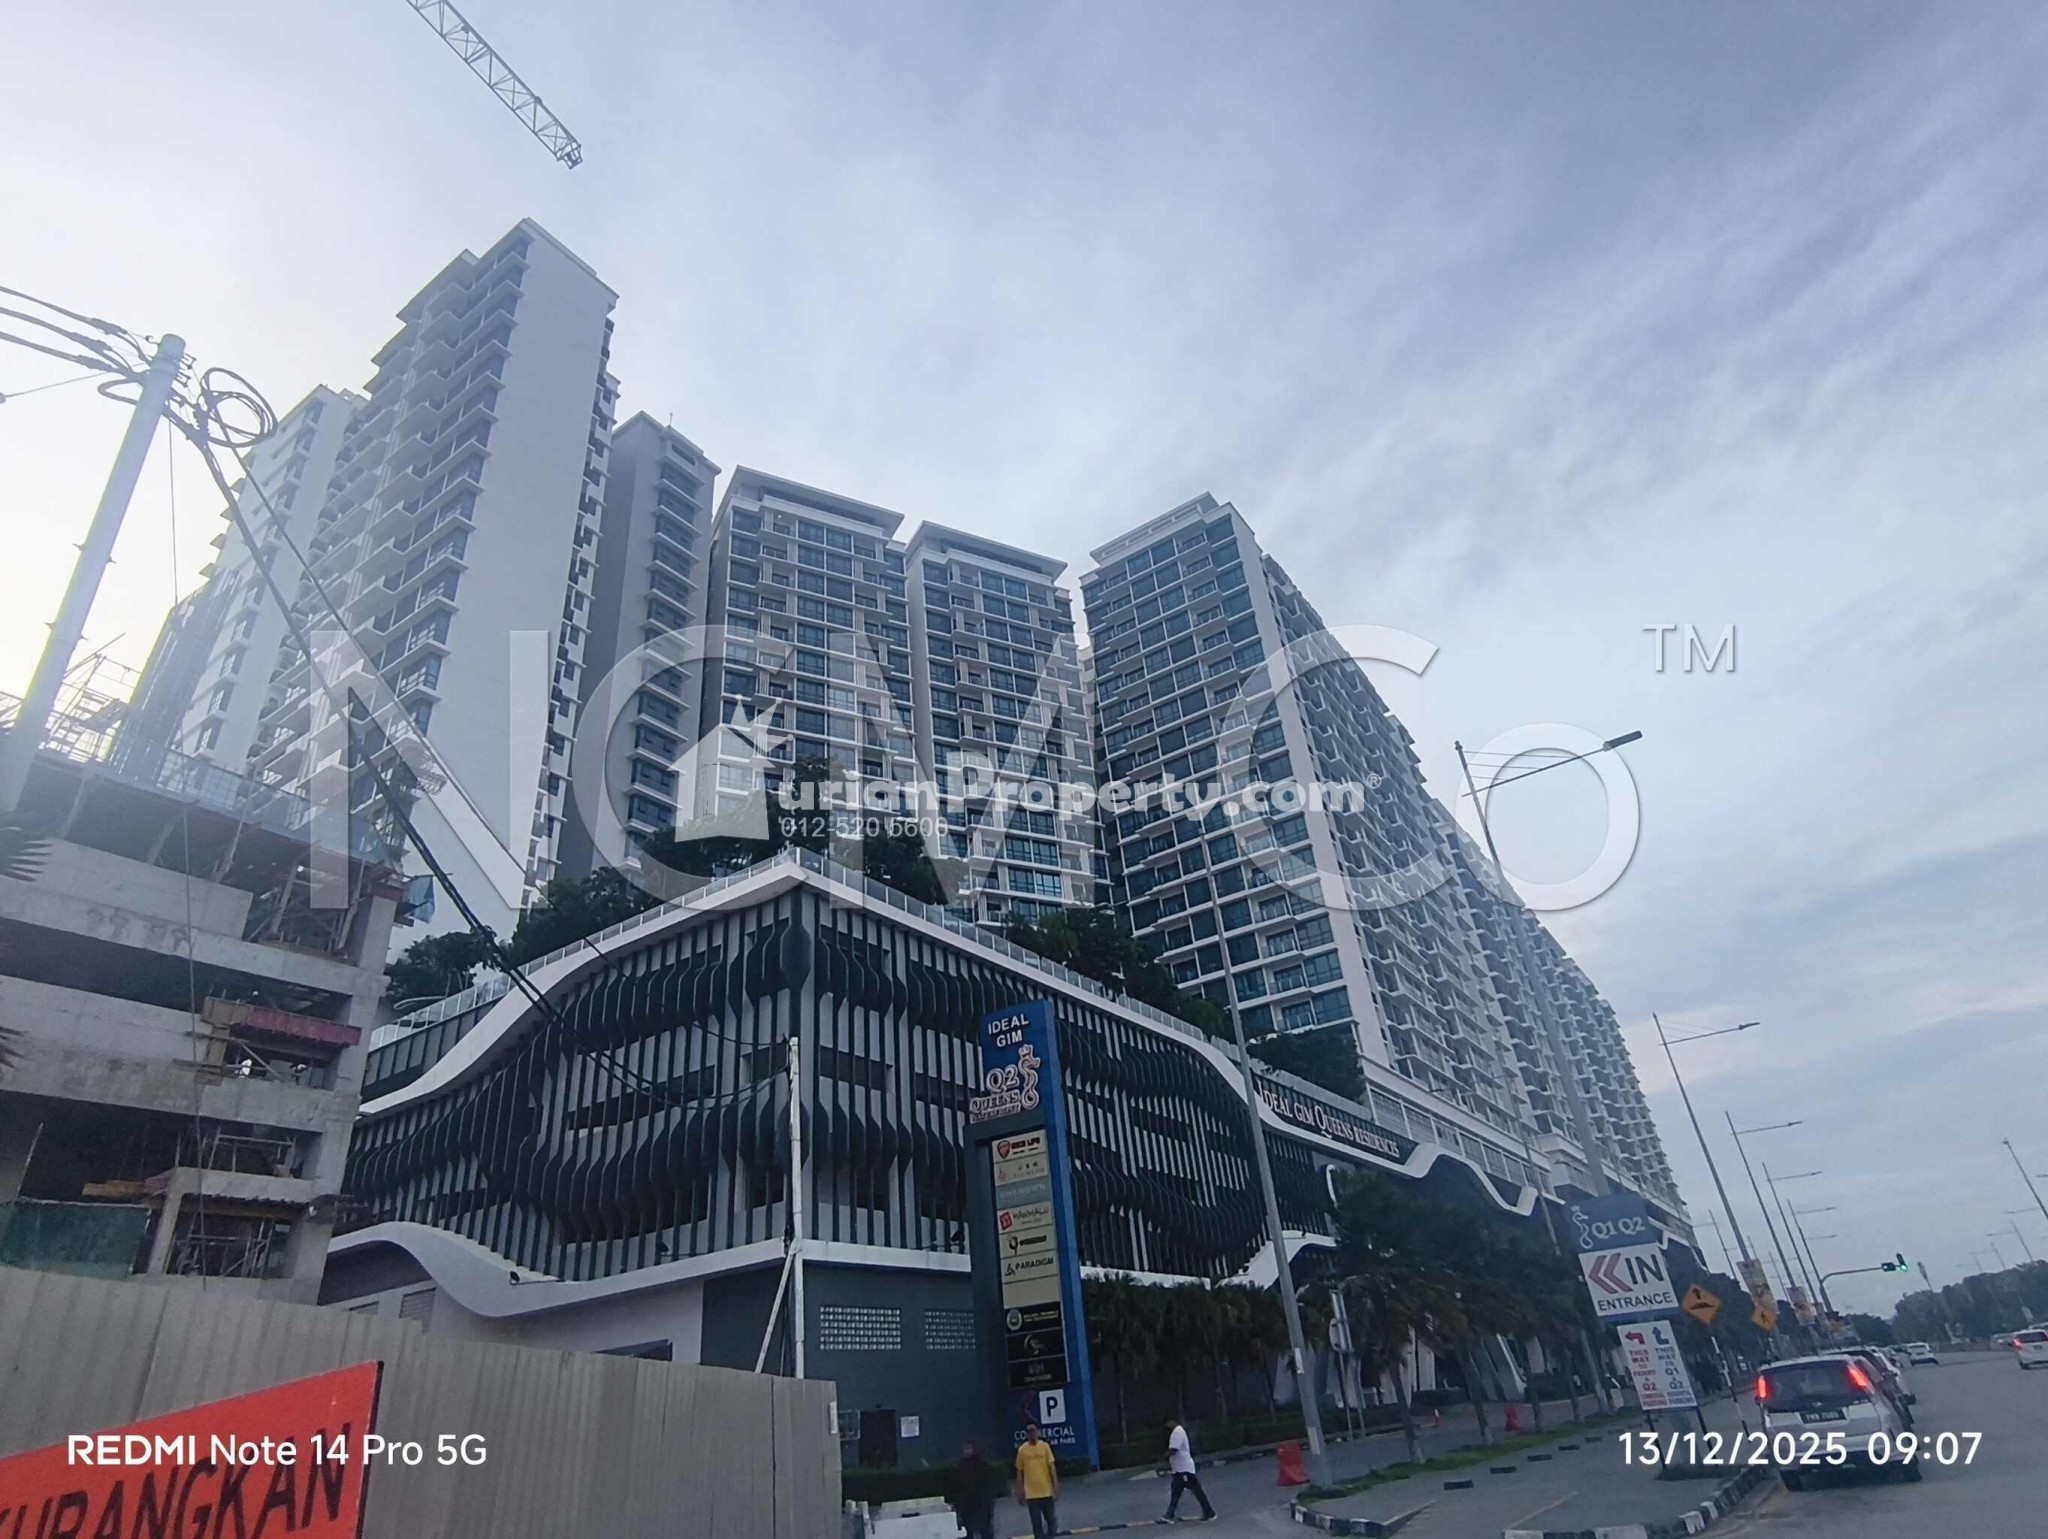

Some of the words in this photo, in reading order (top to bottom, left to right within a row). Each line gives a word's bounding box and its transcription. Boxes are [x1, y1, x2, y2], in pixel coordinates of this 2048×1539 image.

[987, 1012, 1030, 1035] IDEAL
[996, 1029, 1023, 1048] GIM
[986, 1063, 1020, 1094] Q2
[969, 1090, 1021, 1114] QUEENS
[1256, 1076, 1293, 1118] IDEAL
[1294, 1102, 1314, 1126] GIM
[1314, 1104, 1354, 1143] QUEENS
[1353, 1125, 1401, 1159] RESIDENCES
[1591, 1220, 1618, 1240] Q1
[1618, 1216, 1647, 1236] Q2
[1015, 1256, 1055, 1271] PARADIGM
[1624, 1253, 1665, 1285] IN
[1598, 1291, 1674, 1312] ENTRANCE
[1665, 1367, 1679, 1376] Q1
[1642, 1383, 1657, 1391] Q2
[1669, 1381, 1684, 1389] Q2
[1045, 1395, 1059, 1418] P
[1014, 1426, 1075, 1441] COERCIAL
[0, 1422, 352, 1539] RANGKAN
